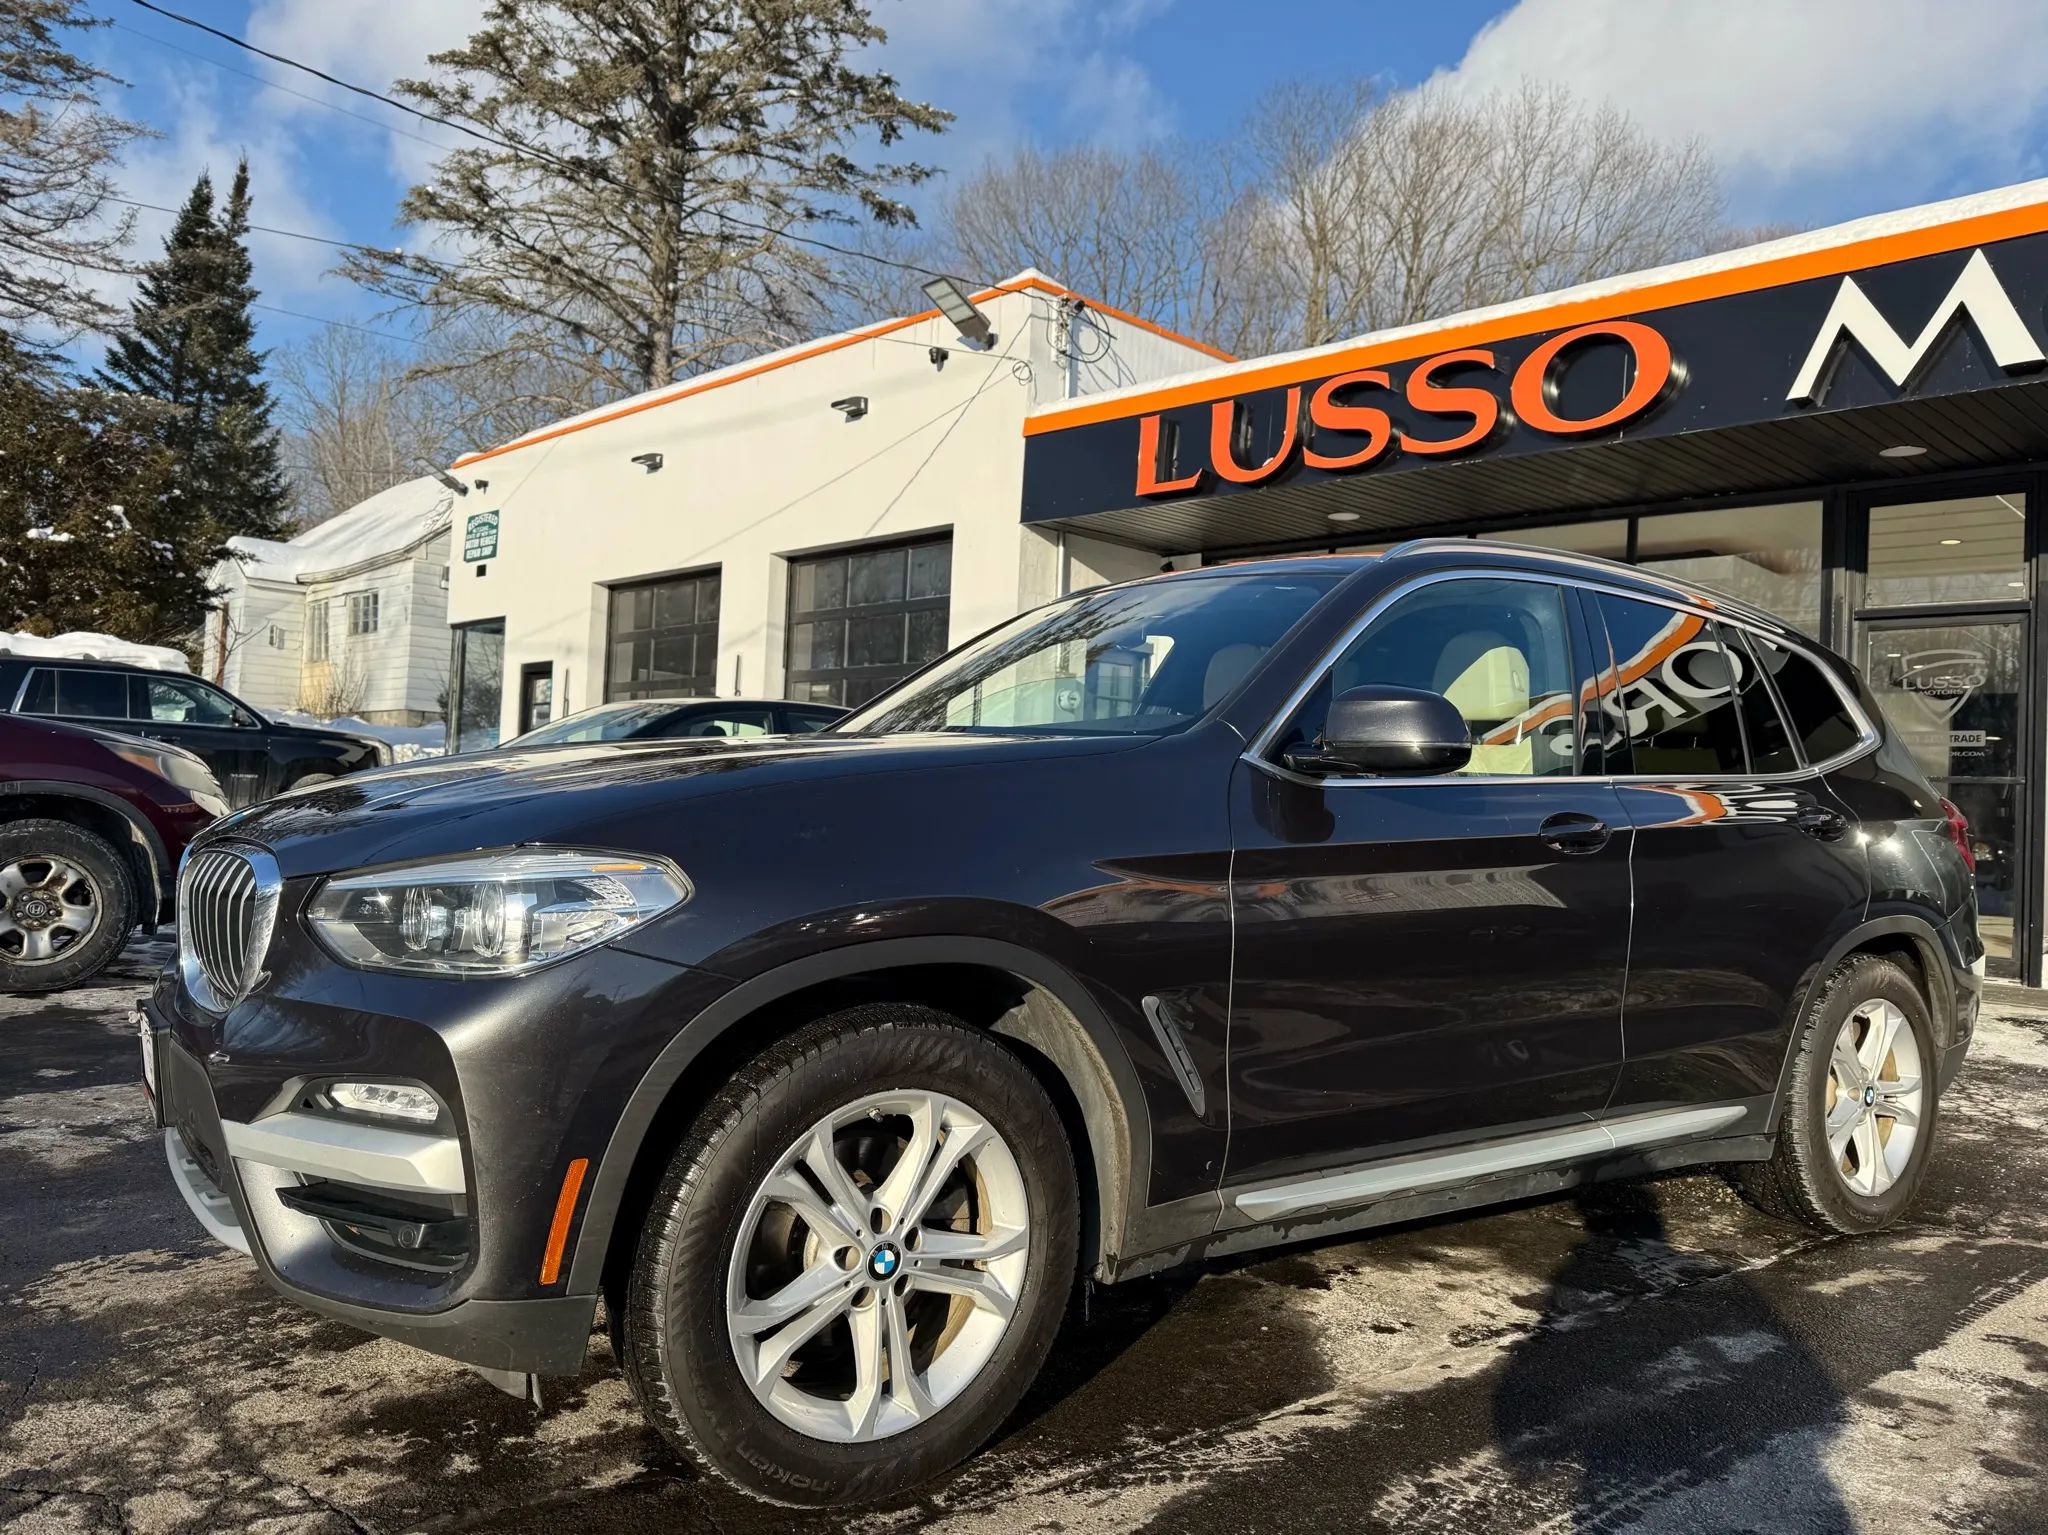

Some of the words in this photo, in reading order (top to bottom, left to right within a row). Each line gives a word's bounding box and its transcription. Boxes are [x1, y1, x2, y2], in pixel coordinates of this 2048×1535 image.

[1136, 320, 1672, 496] LUSSO
[1902, 675, 1986, 690] LUSSO
[1949, 734, 1982, 743] TRADE
[735, 1440, 831, 1492] nokian
